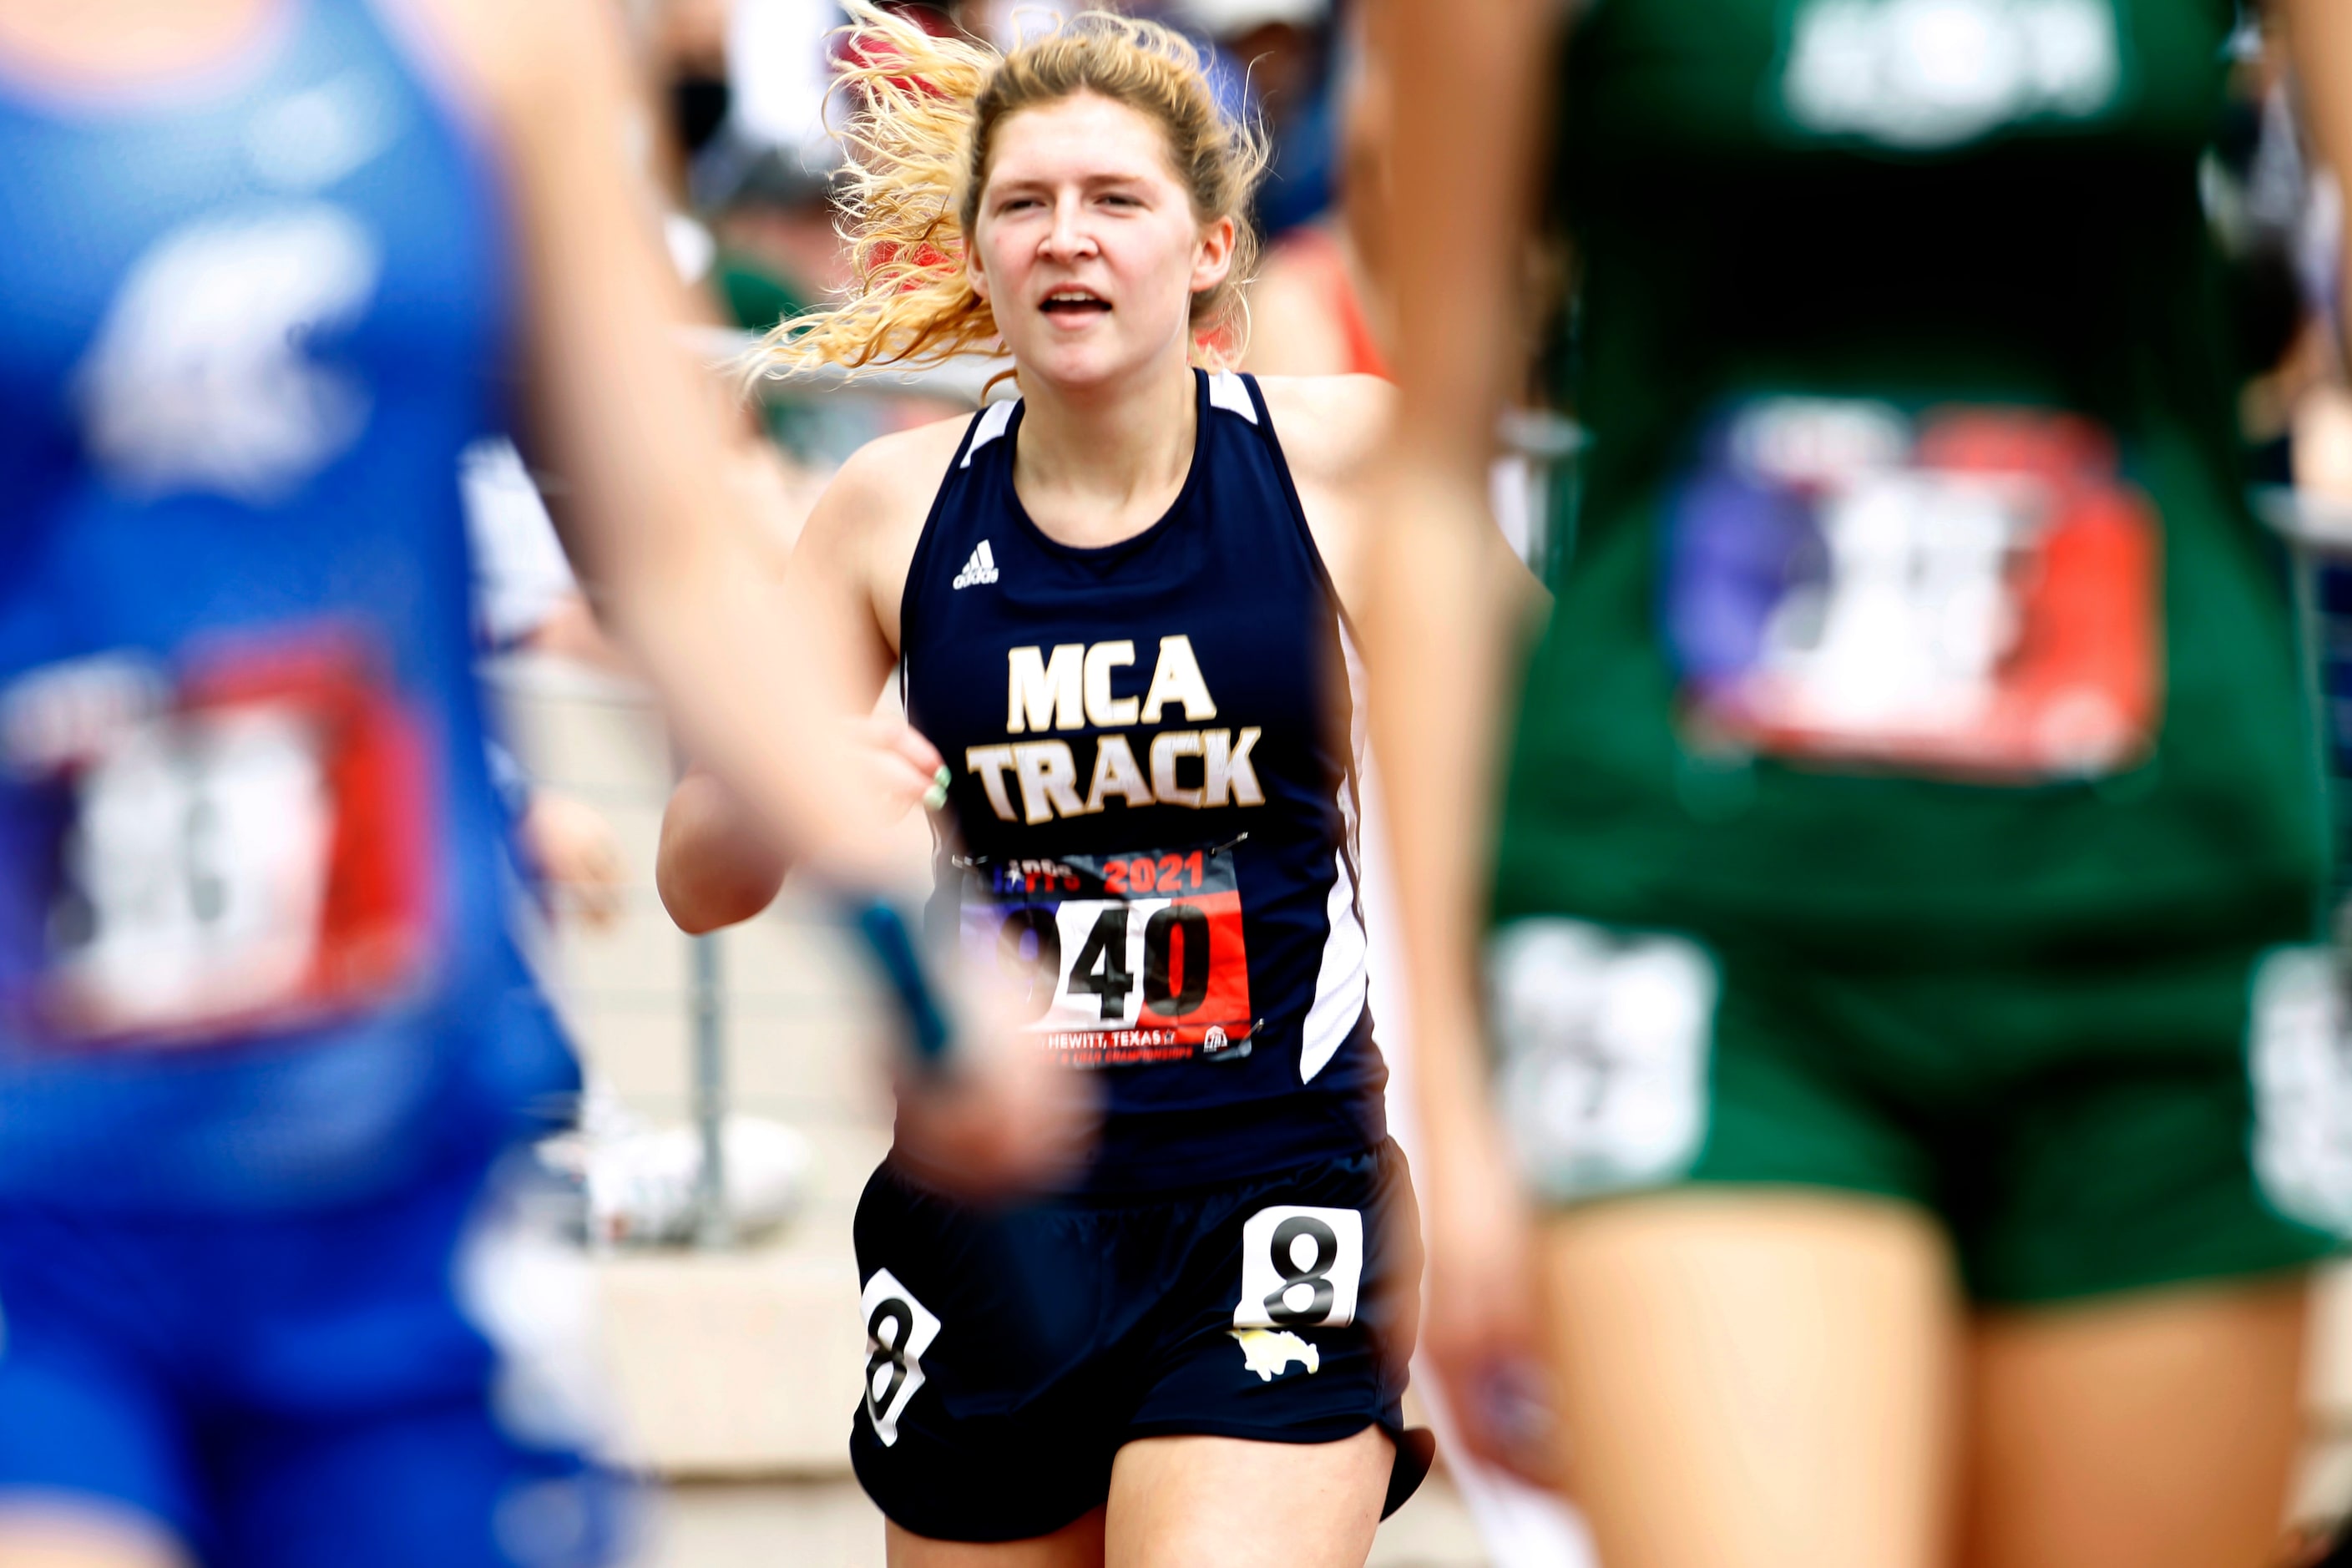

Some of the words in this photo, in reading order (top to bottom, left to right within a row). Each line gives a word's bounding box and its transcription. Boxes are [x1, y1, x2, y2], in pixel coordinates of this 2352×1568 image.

[953, 567, 999, 590] adidas
[1007, 634, 1216, 733] MCA
[965, 726, 1266, 825] TRACK
[1102, 849, 1204, 894] 2021
[1048, 1031, 1107, 1050] HEWITT,
[1110, 1029, 1161, 1048] TEXAS
[1262, 1215, 1338, 1325] 8
[865, 1297, 913, 1421] 8
